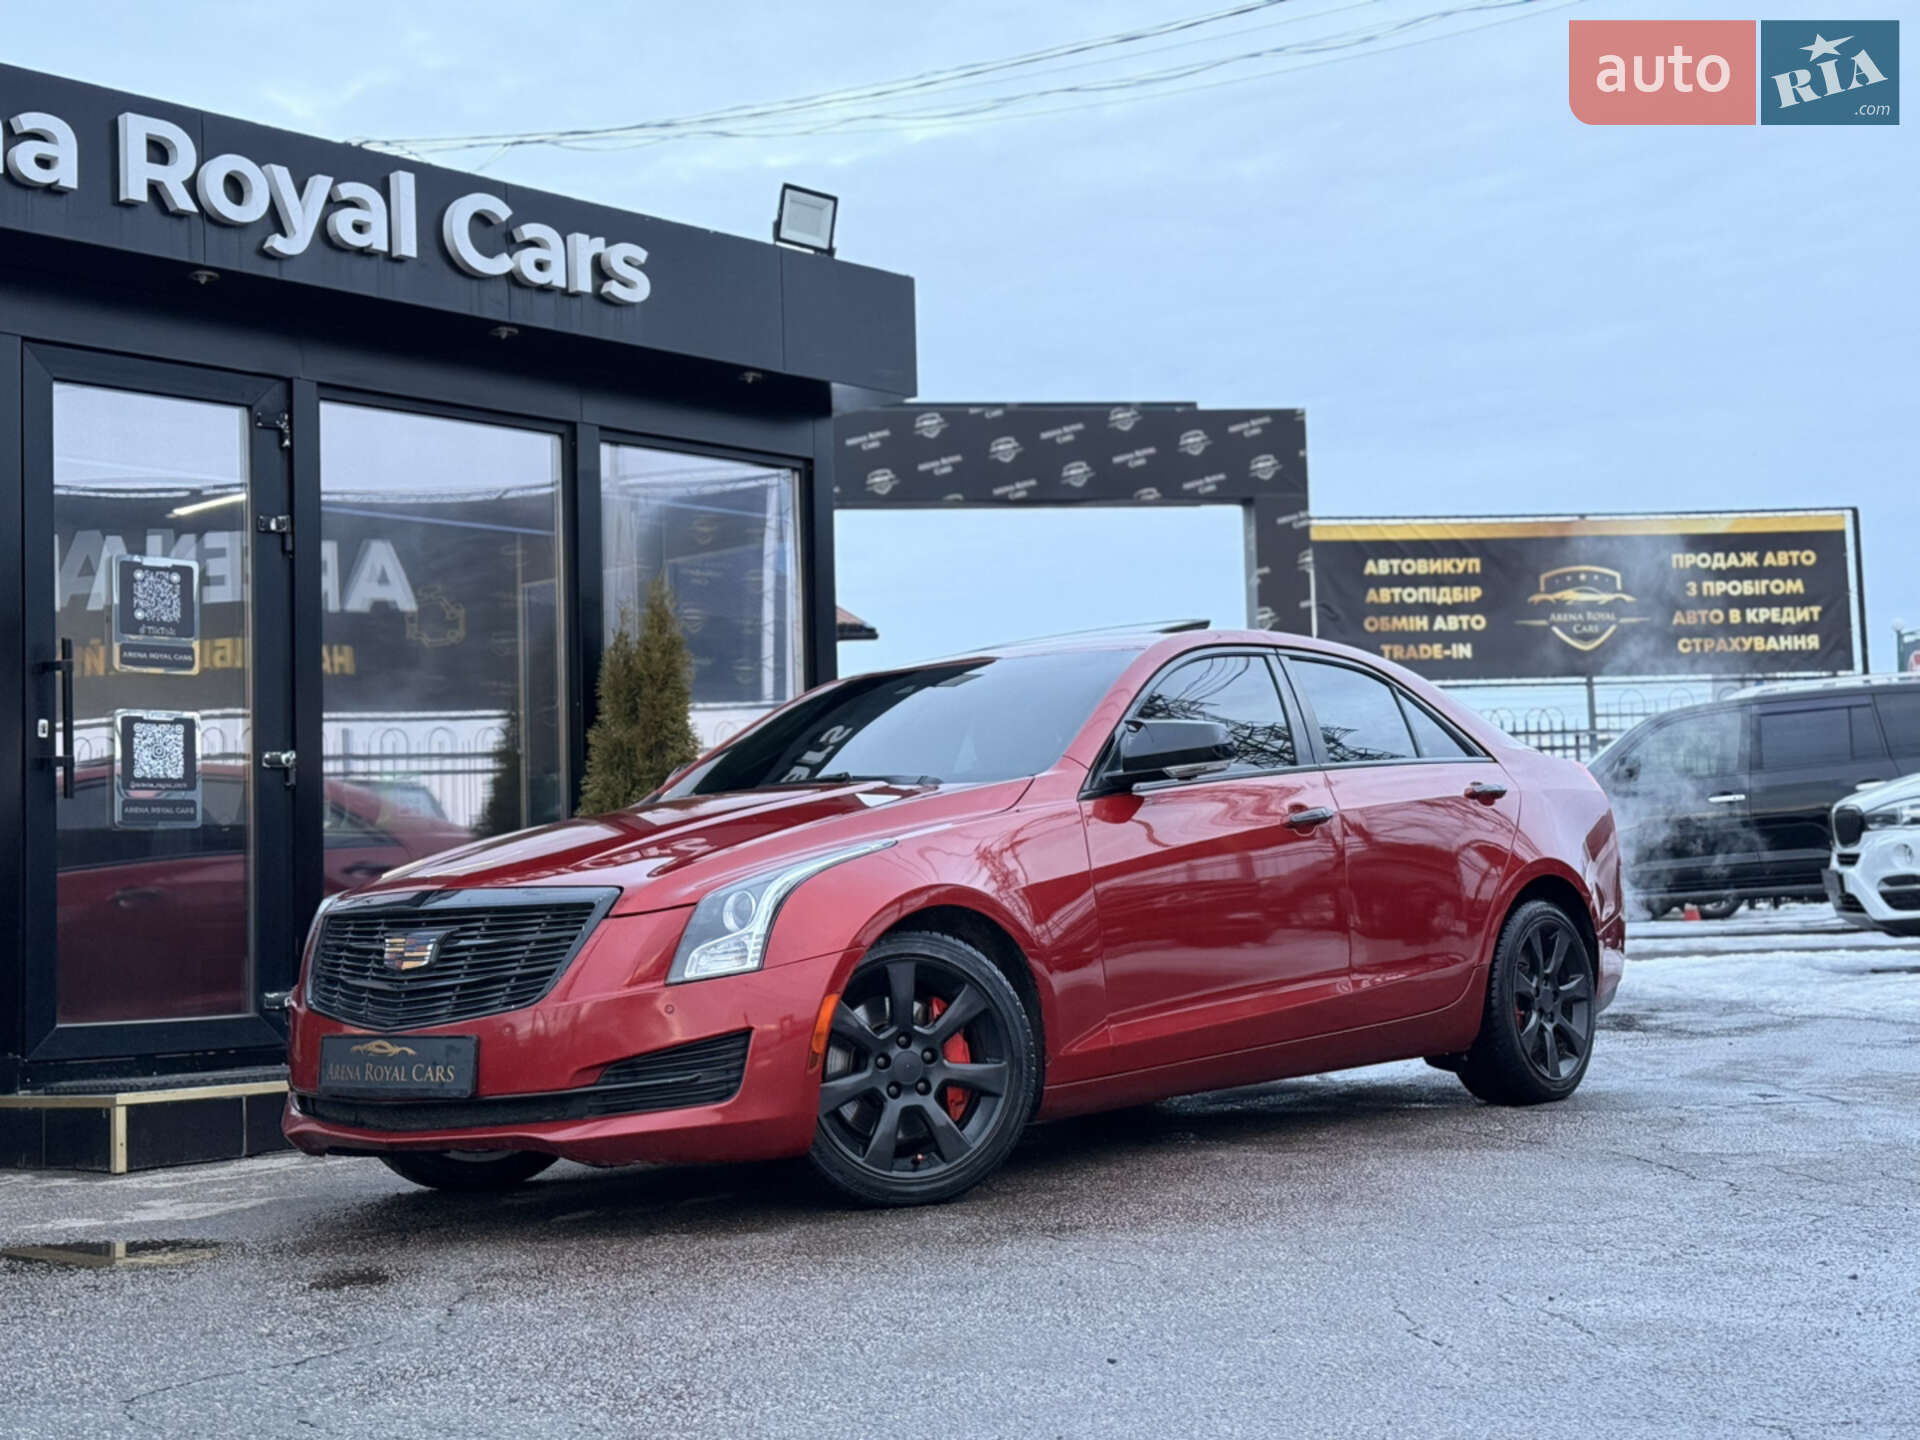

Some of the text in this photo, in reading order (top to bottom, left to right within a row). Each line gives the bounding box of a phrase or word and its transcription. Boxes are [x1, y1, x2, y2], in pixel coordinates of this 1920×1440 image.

[0, 111, 652, 305] a Royal Cars
[1363, 558, 1481, 575] АВТОВИКУП
[1671, 550, 1816, 570] ПРОДАЖ АВТО
[1365, 586, 1483, 605] АВТОПІДБІР
[1702, 579, 1805, 596] ПРОБІГОМ
[1363, 614, 1487, 632] ОБМІН АВТО
[1673, 606, 1822, 625] АВТО В КРЕДИТ
[1381, 643, 1473, 659] TRADE-IN
[1677, 635, 1820, 654] СТРАХУВАННЯ
[327, 1062, 456, 1083] ARENA ROYAL CARS
